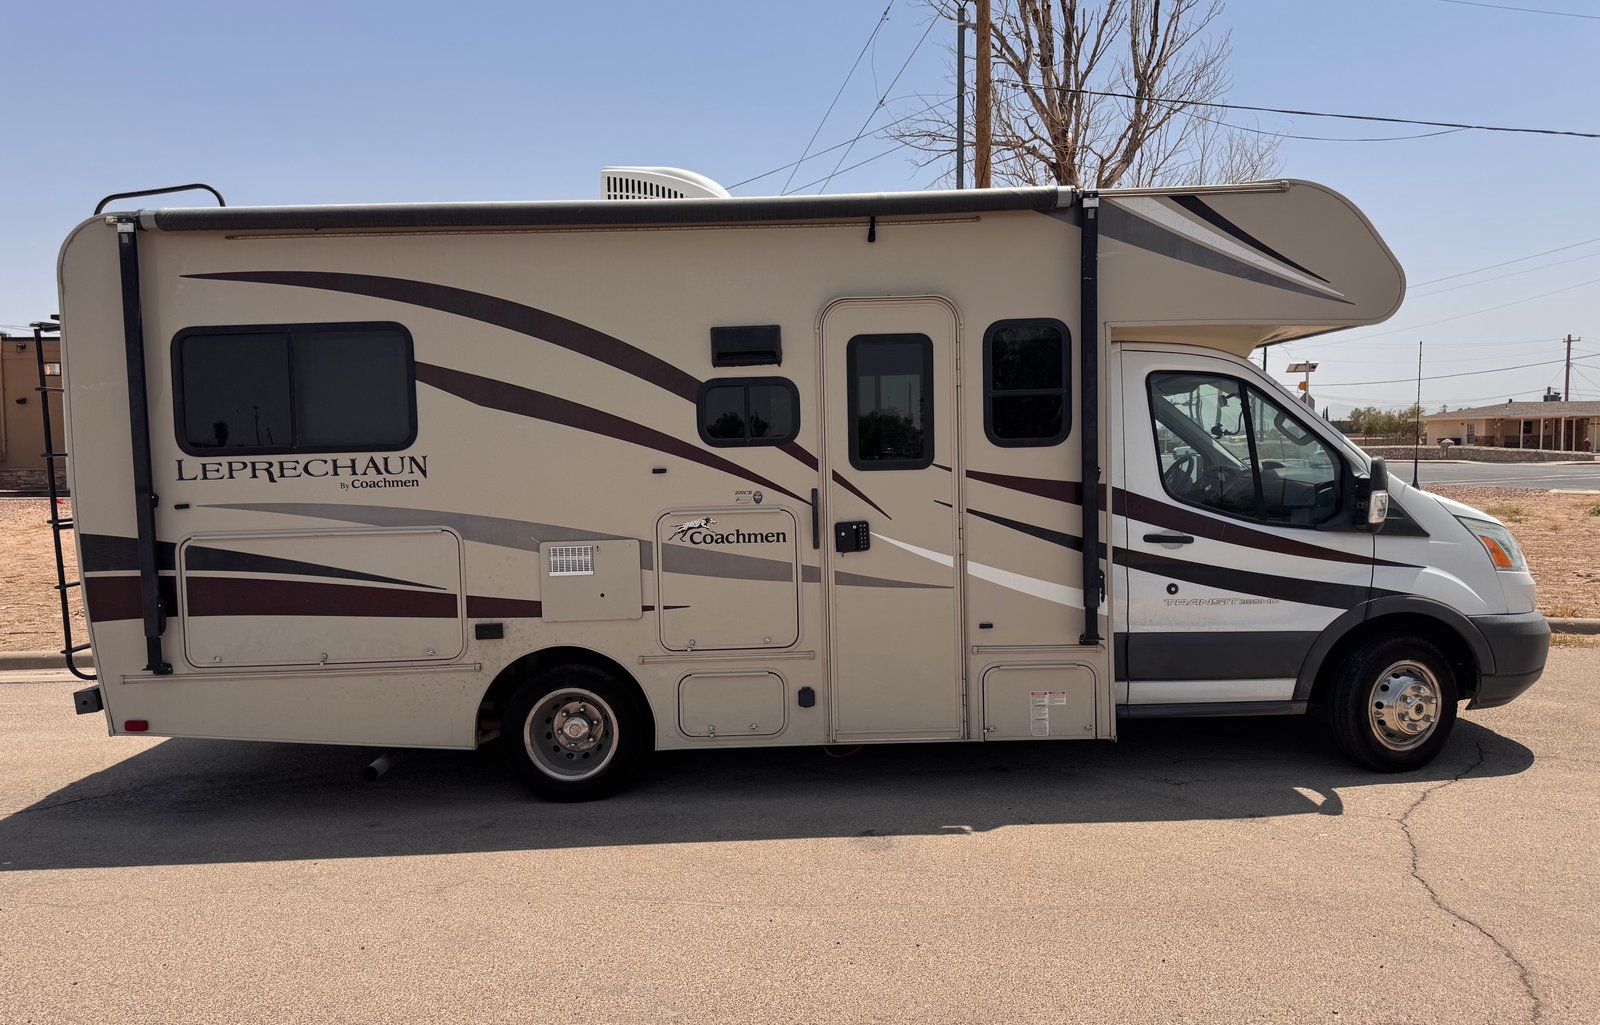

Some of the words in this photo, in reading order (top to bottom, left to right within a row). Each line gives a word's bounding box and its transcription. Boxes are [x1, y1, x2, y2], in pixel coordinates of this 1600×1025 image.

[175, 454, 428, 483] LEPRECHAUN
[340, 482, 350, 491] By
[351, 478, 419, 489] Coachmen
[689, 529, 787, 545] Coachmen
[1163, 598, 1239, 606] TRANSIT
